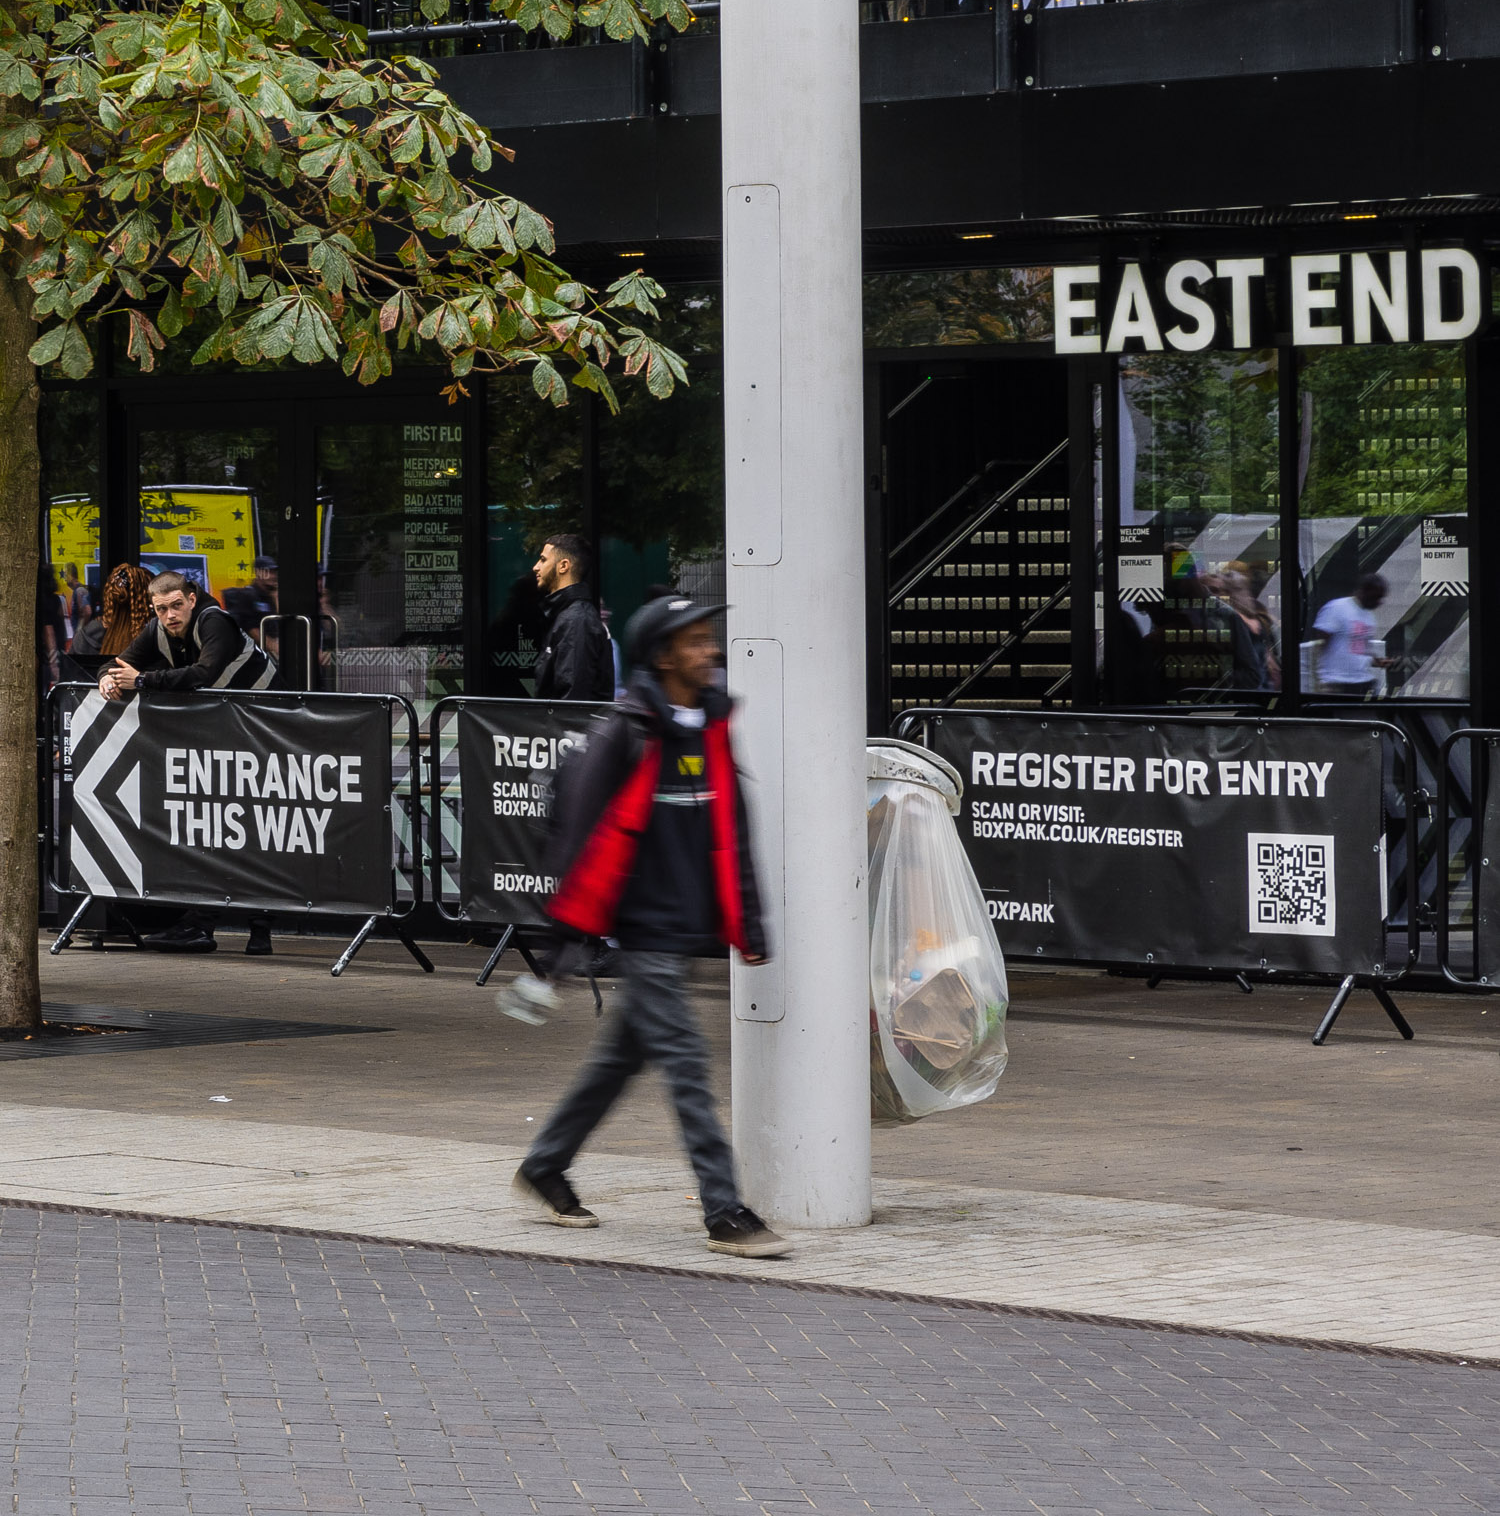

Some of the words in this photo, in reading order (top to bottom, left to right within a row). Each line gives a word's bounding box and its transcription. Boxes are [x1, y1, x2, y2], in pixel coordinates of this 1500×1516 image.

[1052, 258, 1265, 354] EAST
[1290, 248, 1481, 346] END
[404, 426, 437, 441] FIRST
[226, 446, 256, 460] FIRST
[404, 458, 457, 470] MEETSPACE
[404, 494, 425, 506] BAD
[425, 494, 443, 506] AXE
[404, 523, 423, 534] POP
[425, 523, 448, 534] GOLF
[1423, 519, 1437, 527] EAT.
[1120, 528, 1150, 536] WELCOME
[1424, 536, 1439, 544] STAY
[408, 555, 432, 567] PLAY
[436, 555, 456, 567] BOX
[1120, 559, 1152, 567] ENTRANCE
[165, 748, 363, 802] ENTRANCE
[971, 750, 1136, 793] REGISTER
[1145, 758, 1211, 796] FOR
[1218, 760, 1334, 798] ENTRY
[492, 781, 529, 800] SCAN
[971, 801, 1014, 821] SCAN
[1018, 803, 1041, 822] OR
[1042, 804, 1086, 824] VISIT:
[164, 799, 247, 850] THIS
[253, 804, 333, 855] WAY
[972, 820, 1184, 848] BOXPARK.CO.UK/REGISTER
